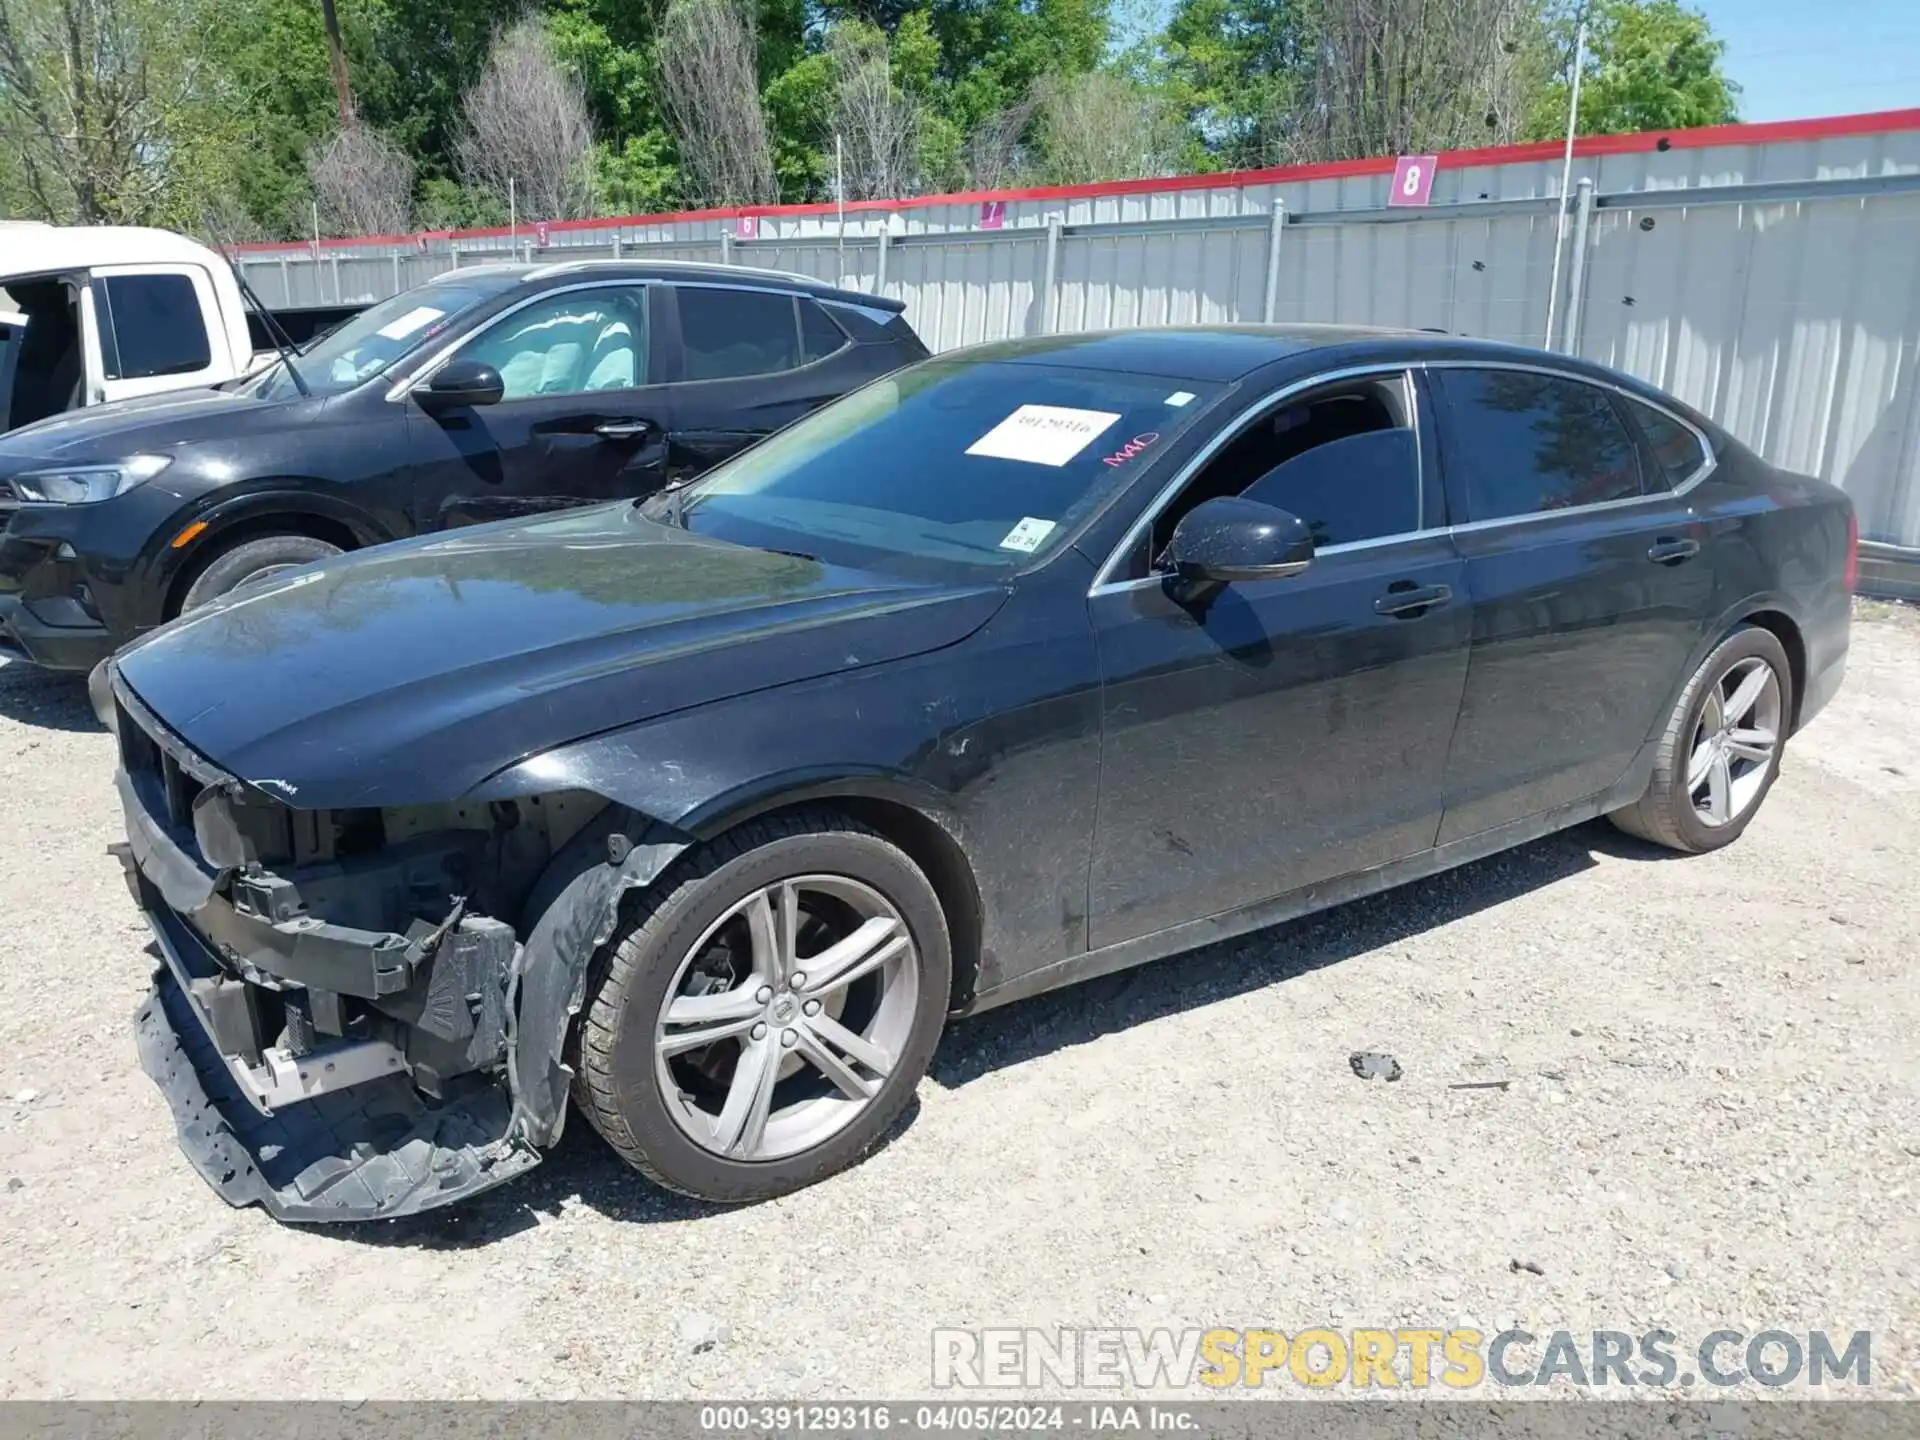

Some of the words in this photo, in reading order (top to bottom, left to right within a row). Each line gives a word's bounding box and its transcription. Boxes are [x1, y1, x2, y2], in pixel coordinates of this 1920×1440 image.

[1403, 165, 1420, 196] 8
[988, 201, 999, 223] 7
[743, 217, 752, 234] 6
